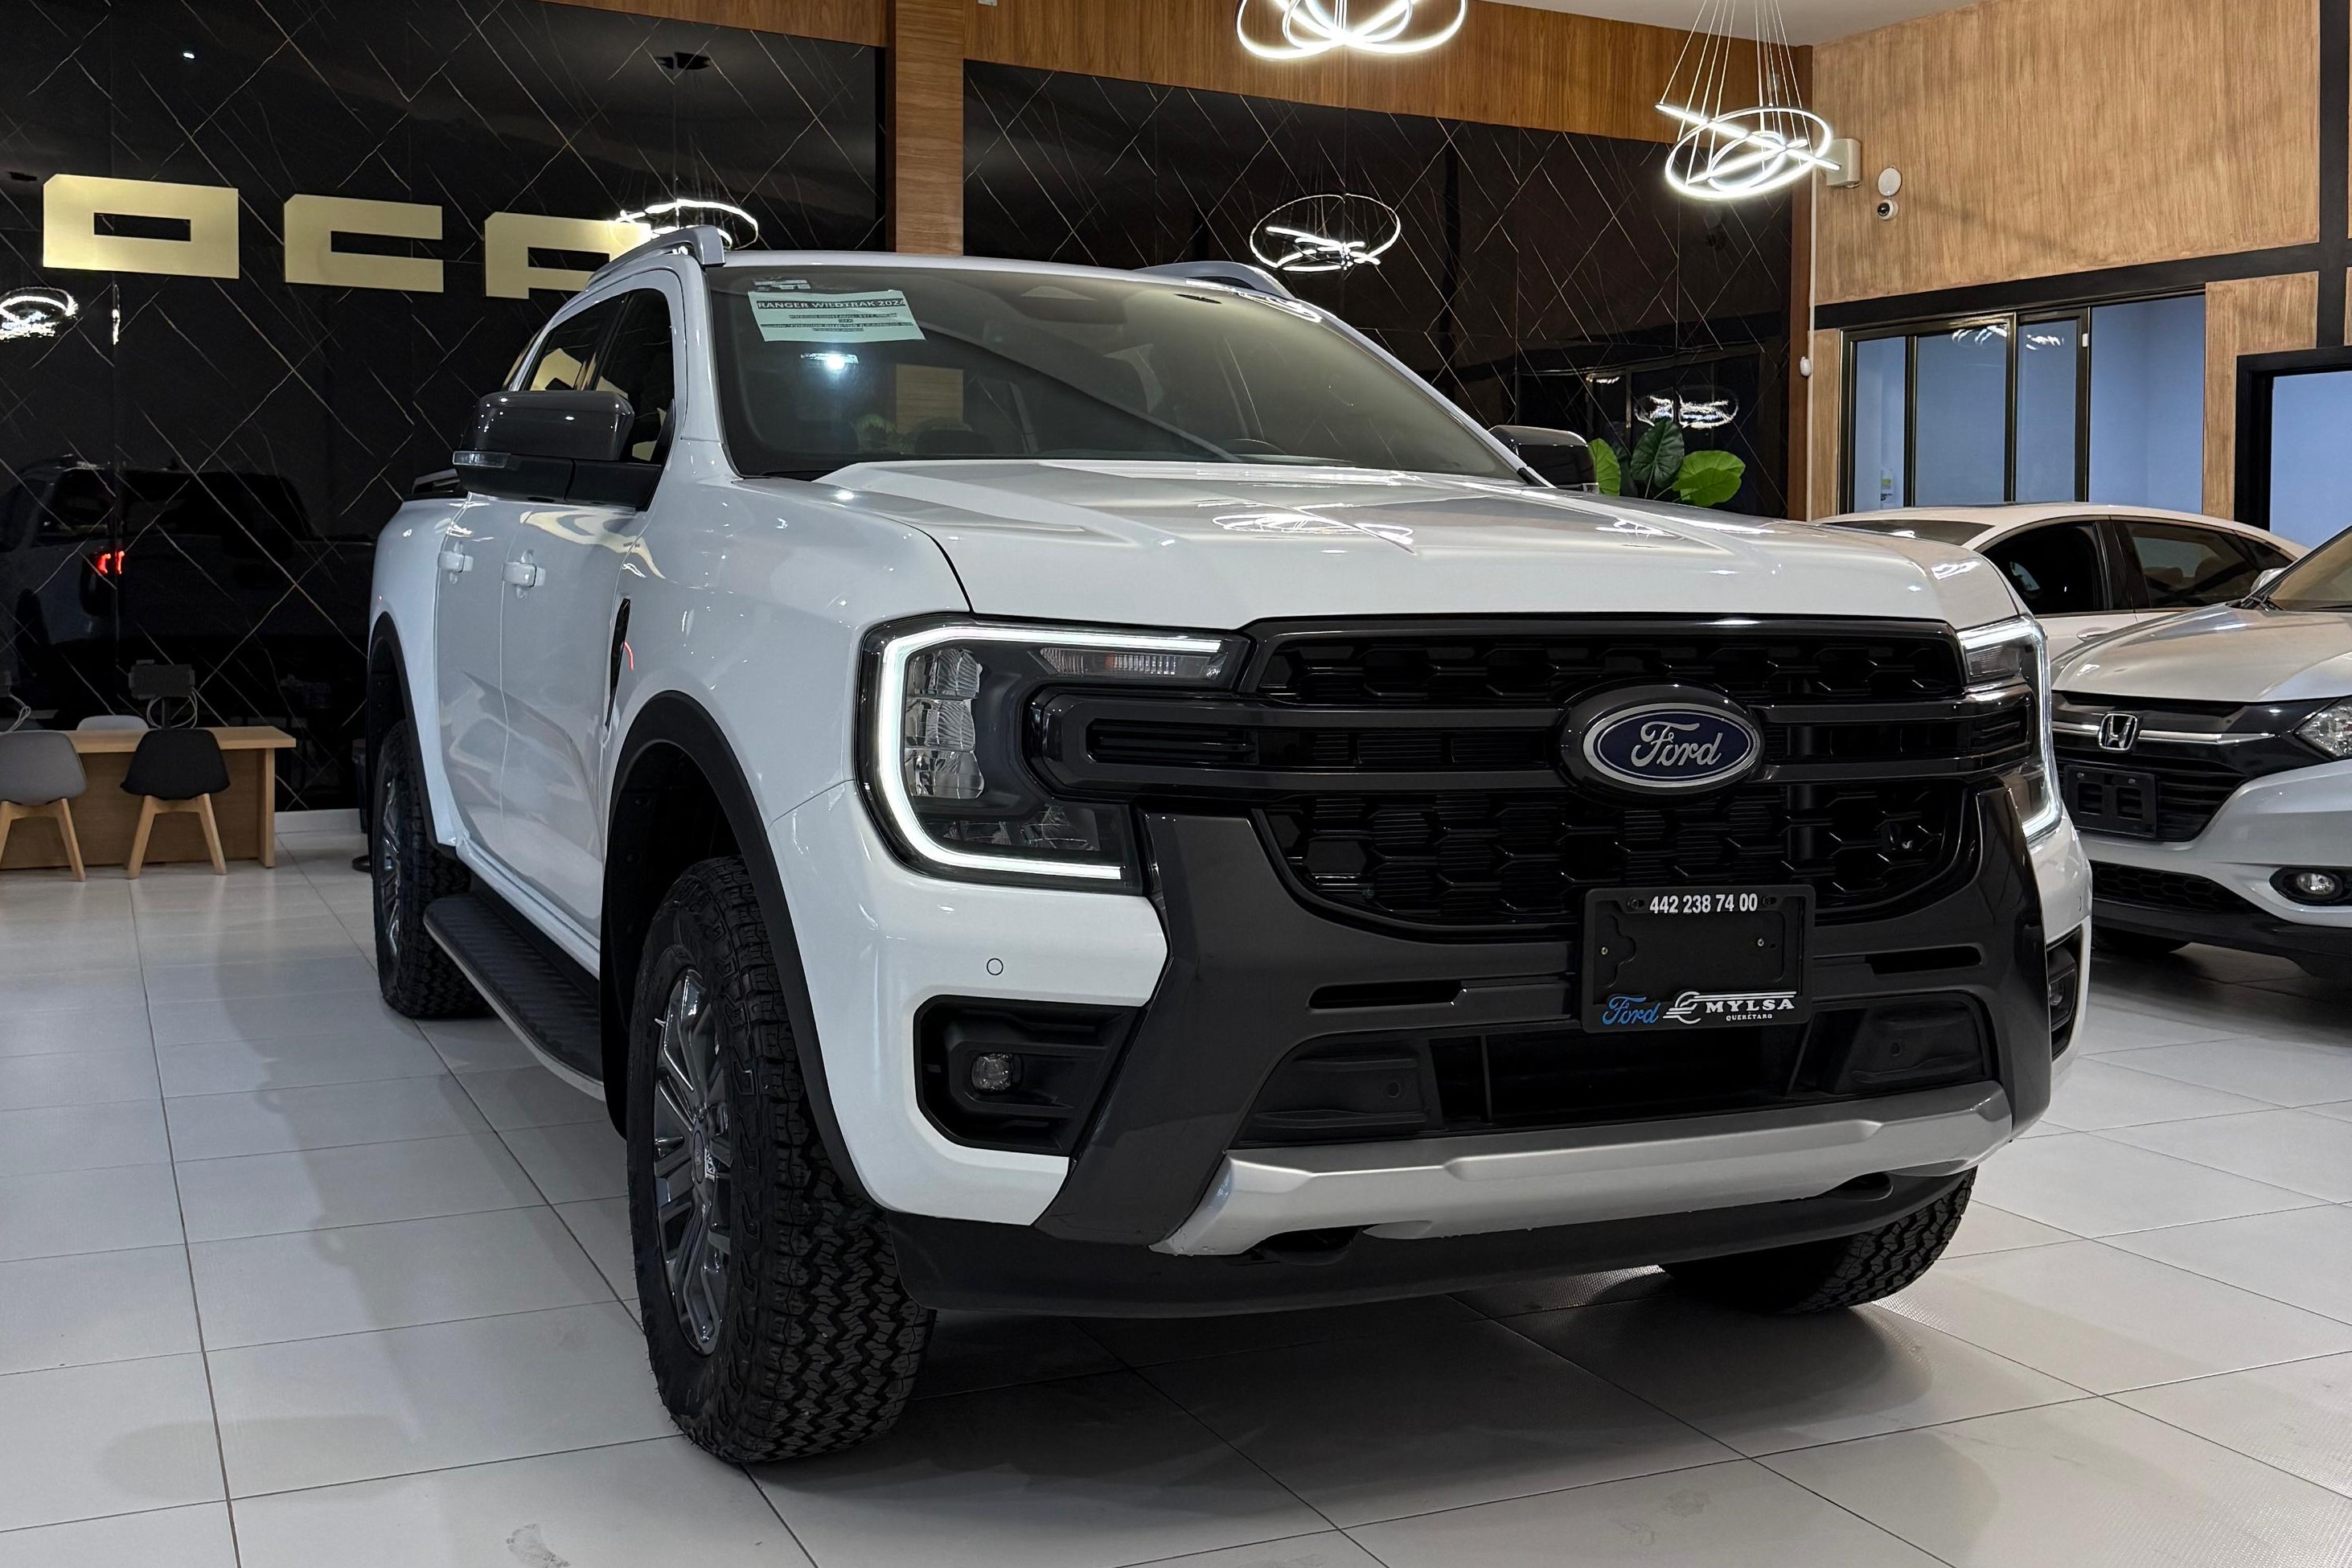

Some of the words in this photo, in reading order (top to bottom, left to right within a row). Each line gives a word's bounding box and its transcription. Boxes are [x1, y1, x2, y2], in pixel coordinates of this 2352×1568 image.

[811, 301, 876, 309] WILDTRAK
[1631, 720, 1722, 767] Ford
[1649, 895, 1679, 914] 442
[1683, 894, 1711, 913] 238
[1715, 893, 1734, 913] 74
[1738, 893, 1759, 912] 00
[1602, 995, 1661, 1025] Ford
[1705, 998, 1796, 1013] MYLSA
